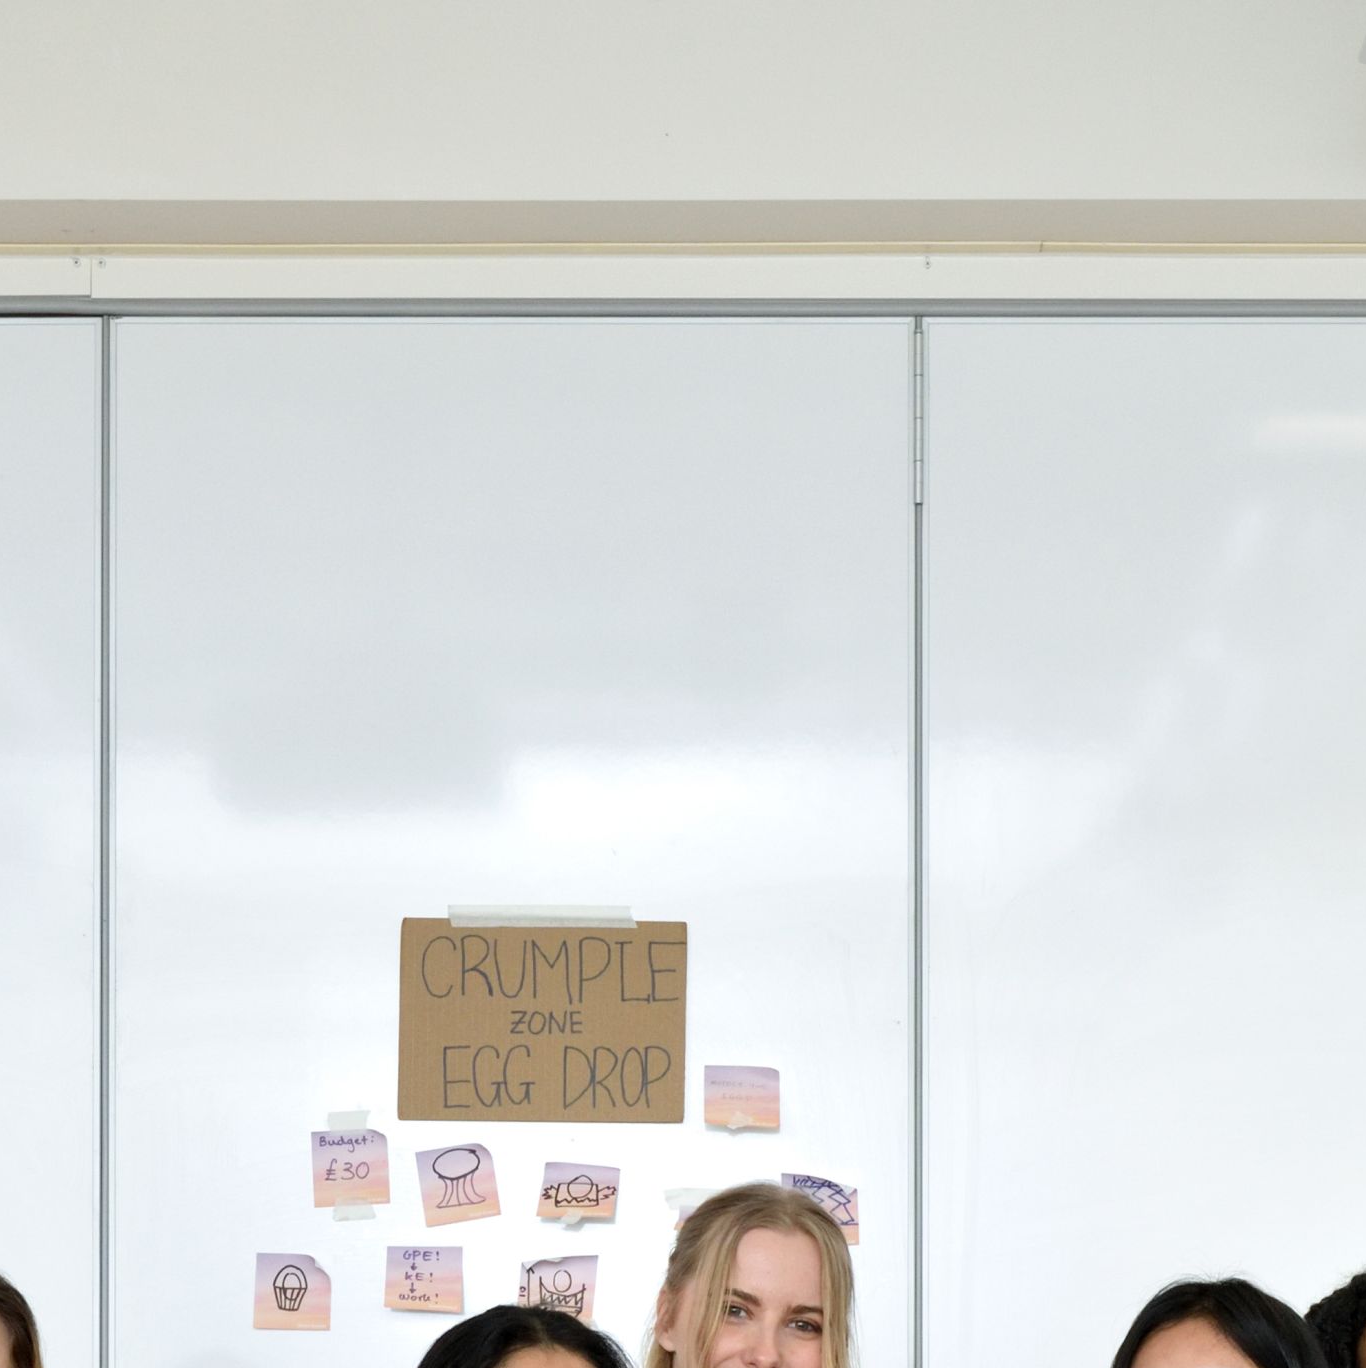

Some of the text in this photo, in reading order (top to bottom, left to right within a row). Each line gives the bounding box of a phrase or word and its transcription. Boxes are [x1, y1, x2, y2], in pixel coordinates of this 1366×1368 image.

[422, 935, 686, 1004] CRUMPLE
[510, 1010, 583, 1035] ZONE
[443, 1045, 671, 1109] EGG DROP
[319, 1135, 374, 1152] Budget:
